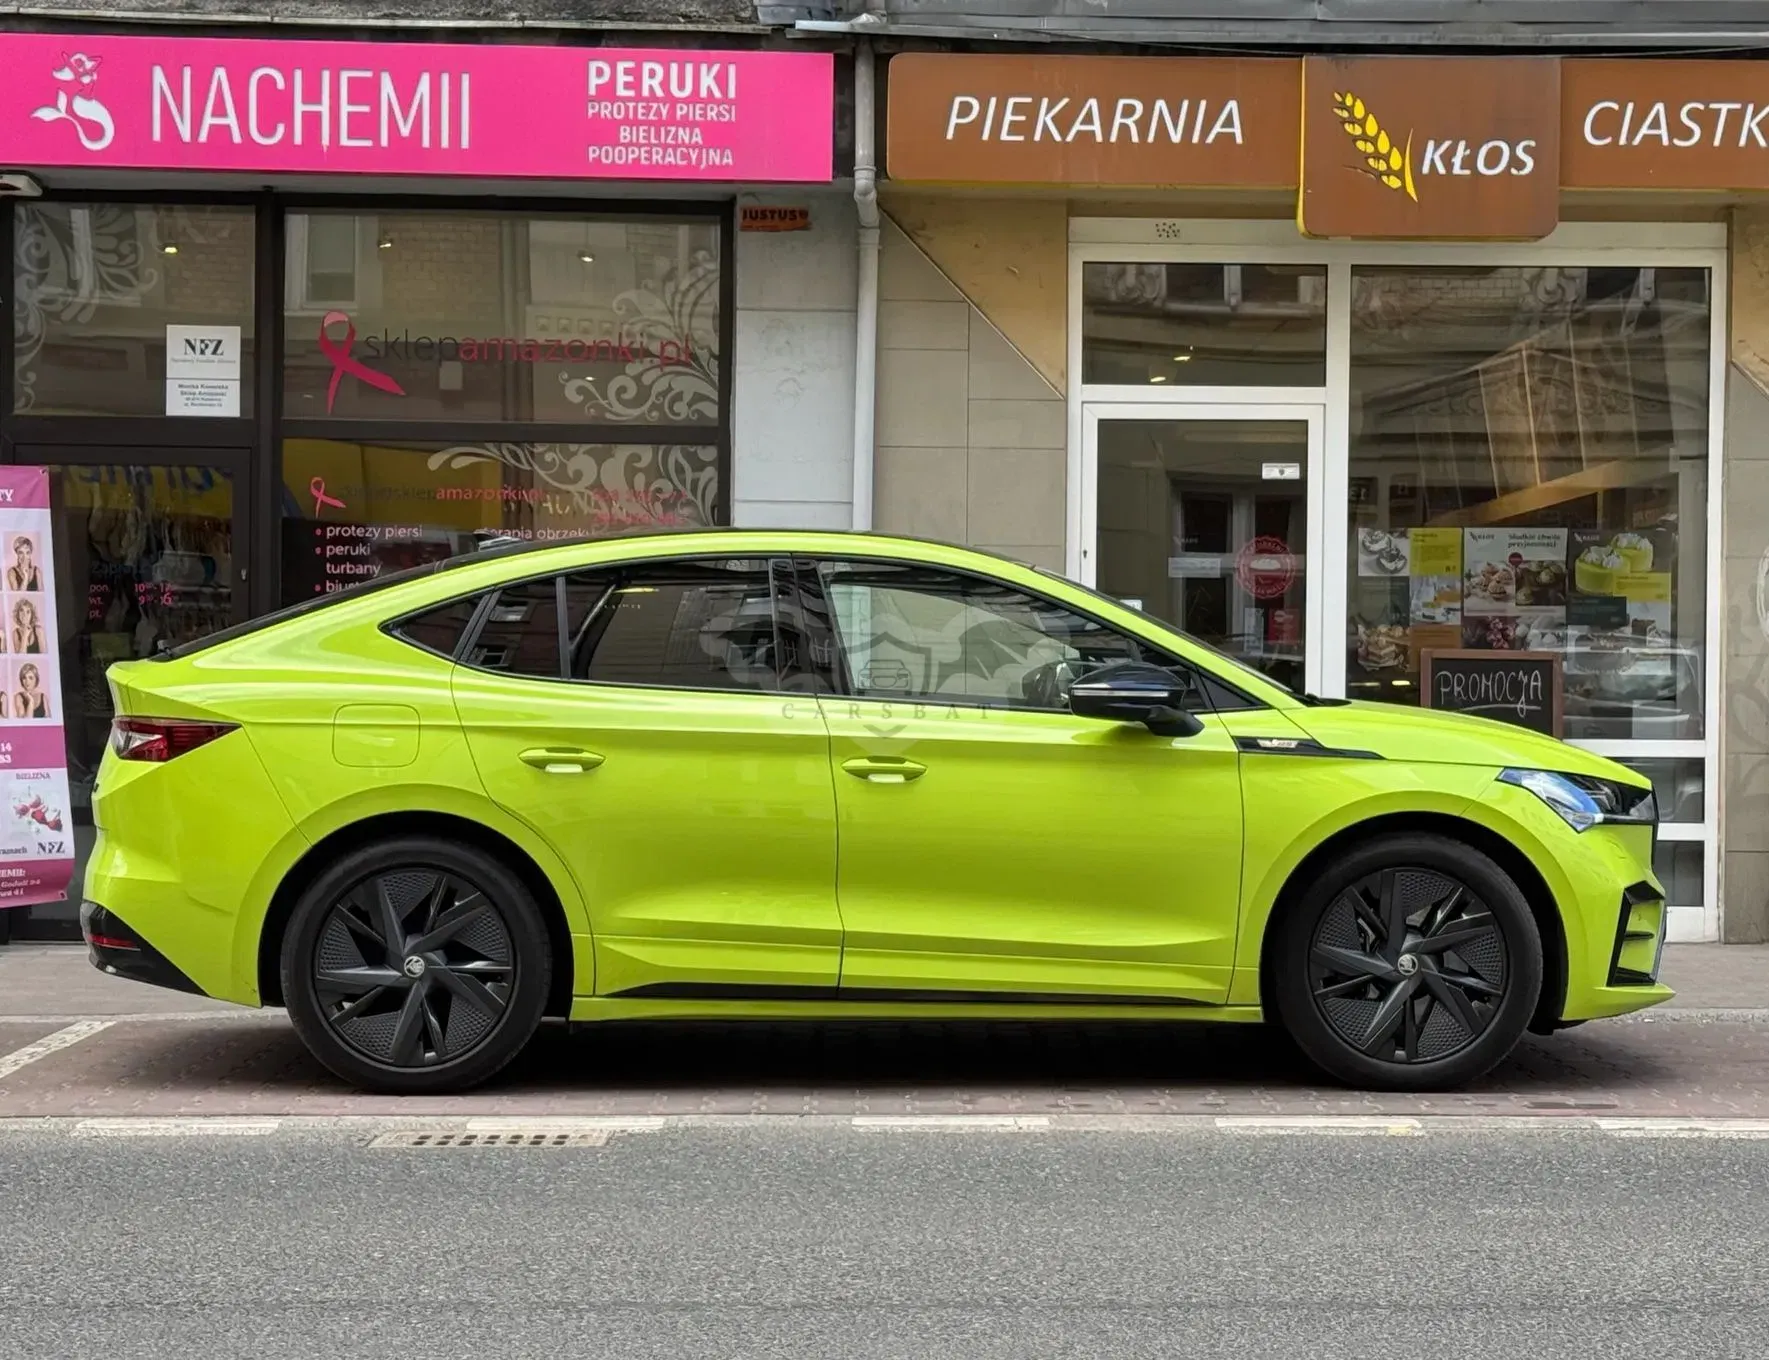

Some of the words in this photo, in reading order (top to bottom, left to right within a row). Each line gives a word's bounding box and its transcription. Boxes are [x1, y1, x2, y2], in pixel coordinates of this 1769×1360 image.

[587, 60, 737, 99] PERUKI
[152, 65, 470, 150] NACHEMII
[587, 101, 670, 121] PROTEZY
[676, 103, 737, 122] PIERSI
[946, 96, 1243, 144] PIEKARNIA
[1583, 101, 1769, 148] CIASTK
[619, 125, 703, 145] BIELIZNA
[587, 146, 733, 169] POOPERACYJNA
[1421, 139, 1536, 175] KŁOS
[184, 338, 224, 355] NFZ
[326, 525, 381, 540] protezy
[385, 525, 423, 540] piersi
[326, 543, 371, 558] peruki
[326, 562, 381, 578] turbany
[1435, 669, 1542, 717] PROMOCJA
